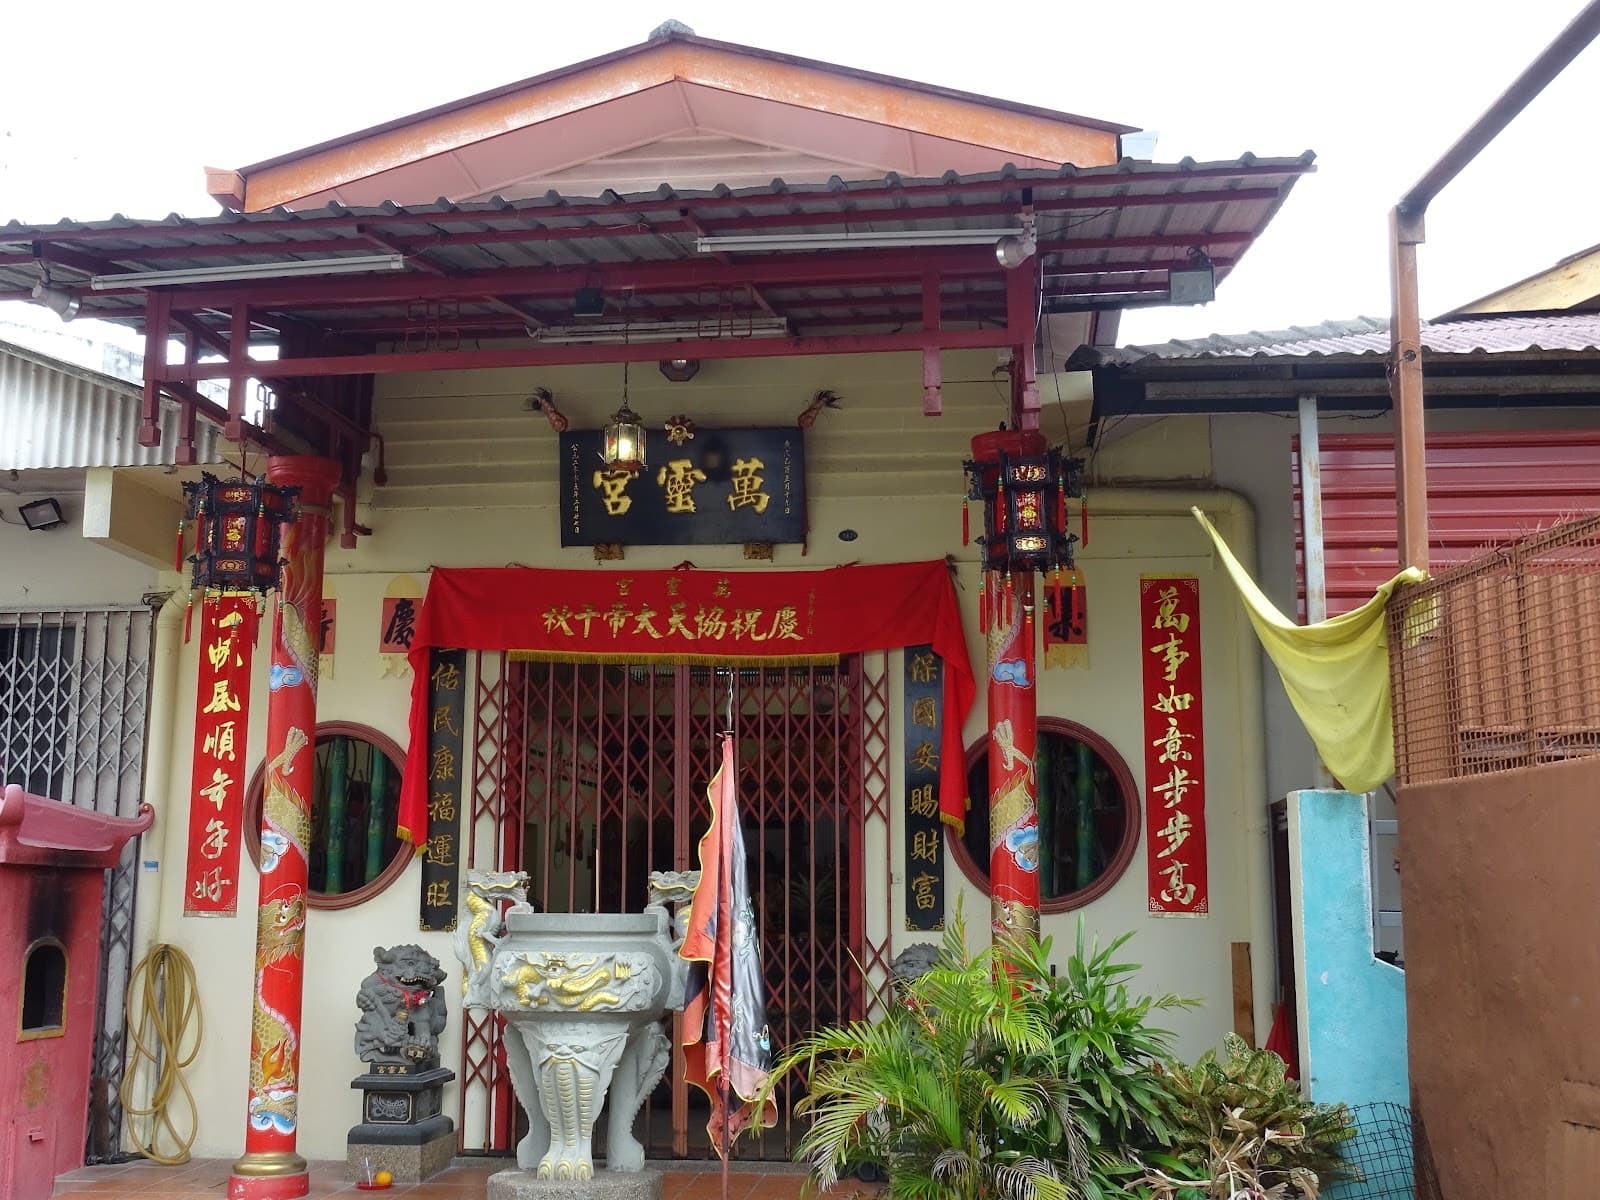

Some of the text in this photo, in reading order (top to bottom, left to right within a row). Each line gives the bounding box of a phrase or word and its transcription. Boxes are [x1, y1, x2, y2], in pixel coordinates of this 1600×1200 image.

[594, 457, 769, 515] 萬靈宮
[542, 602, 804, 641] 慶祝協天大帝千秋
[1150, 586, 1199, 905] 萬事如意步步高
[192, 610, 244, 901] 一帆風順年年好
[426, 648, 459, 907] 佑民康福運旺
